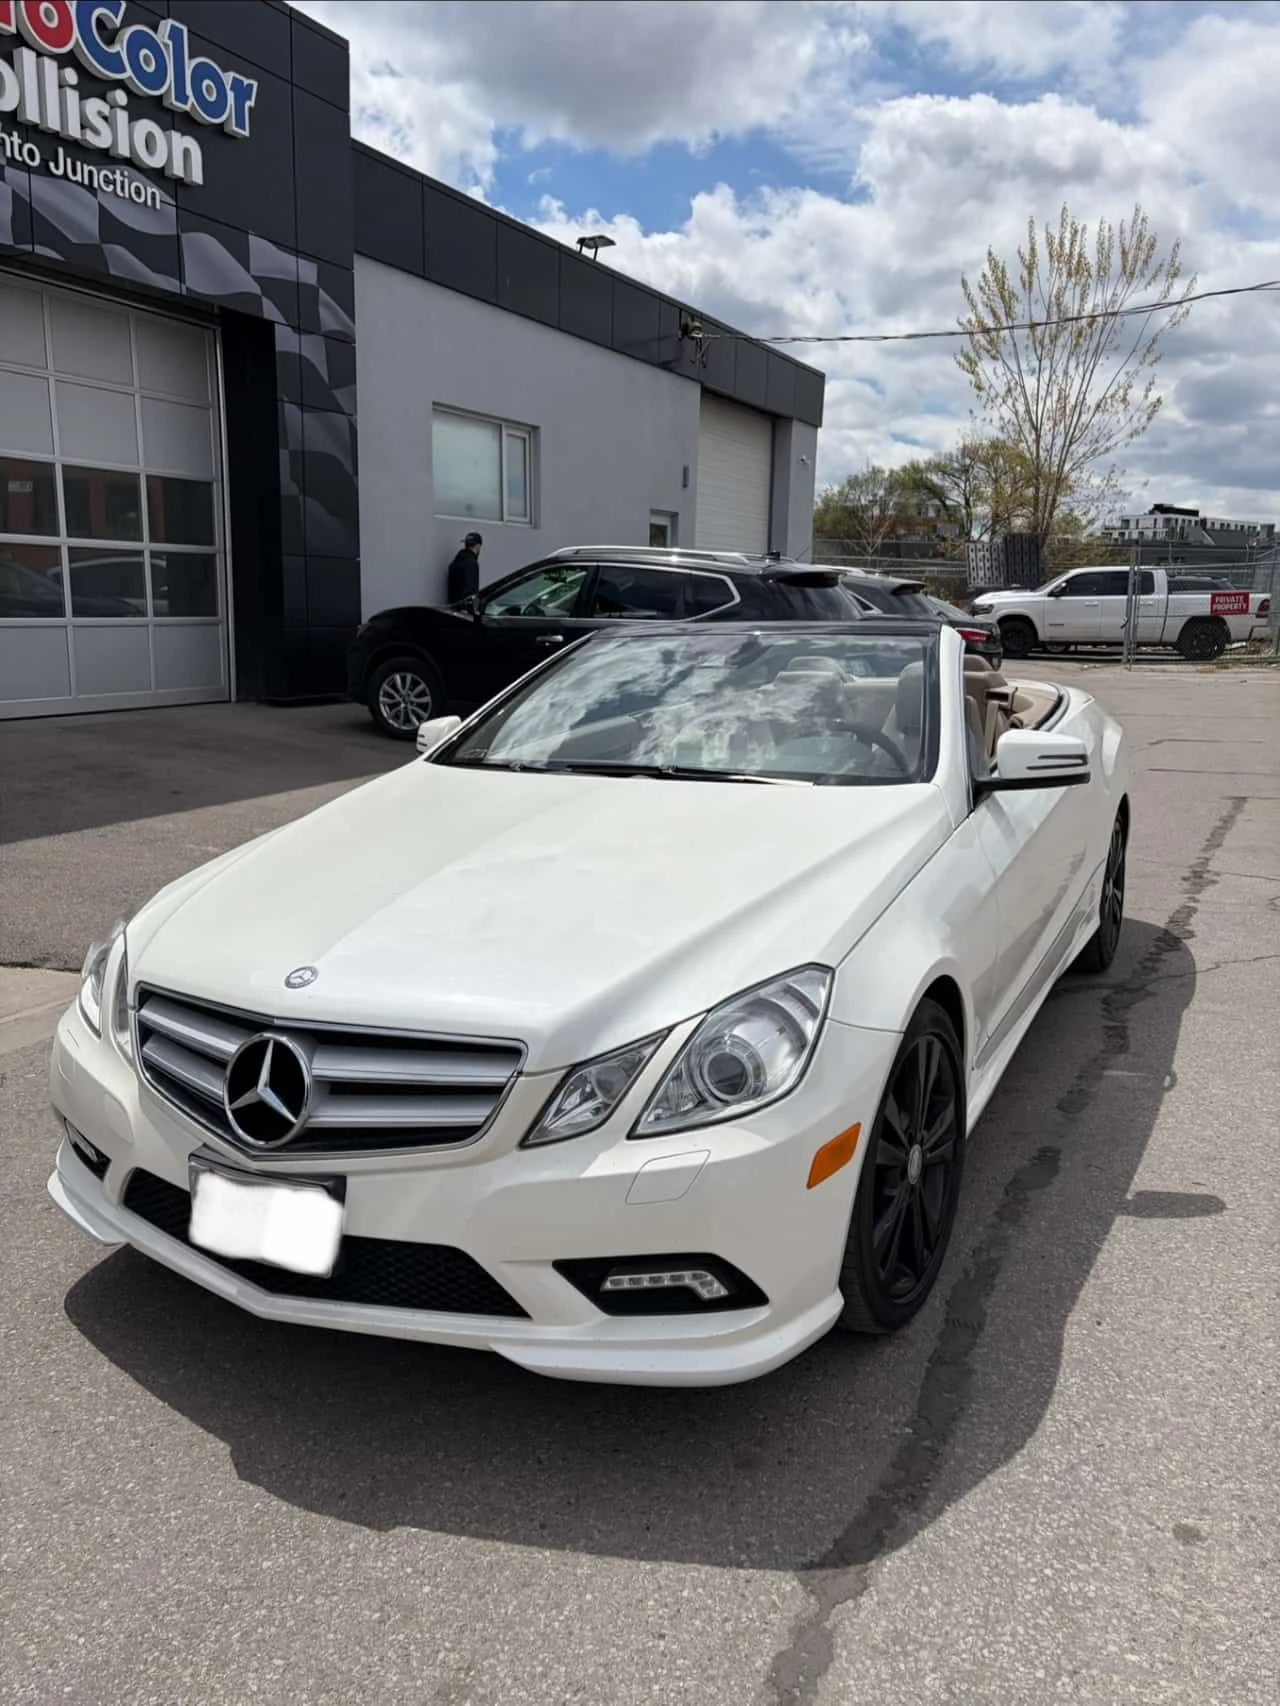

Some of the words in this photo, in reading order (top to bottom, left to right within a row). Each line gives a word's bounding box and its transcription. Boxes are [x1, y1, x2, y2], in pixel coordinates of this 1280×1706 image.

[49, 147, 161, 210] Junction
[1215, 595, 1245, 603] PRIVATE
[1212, 603, 1247, 611] PROPERTY
